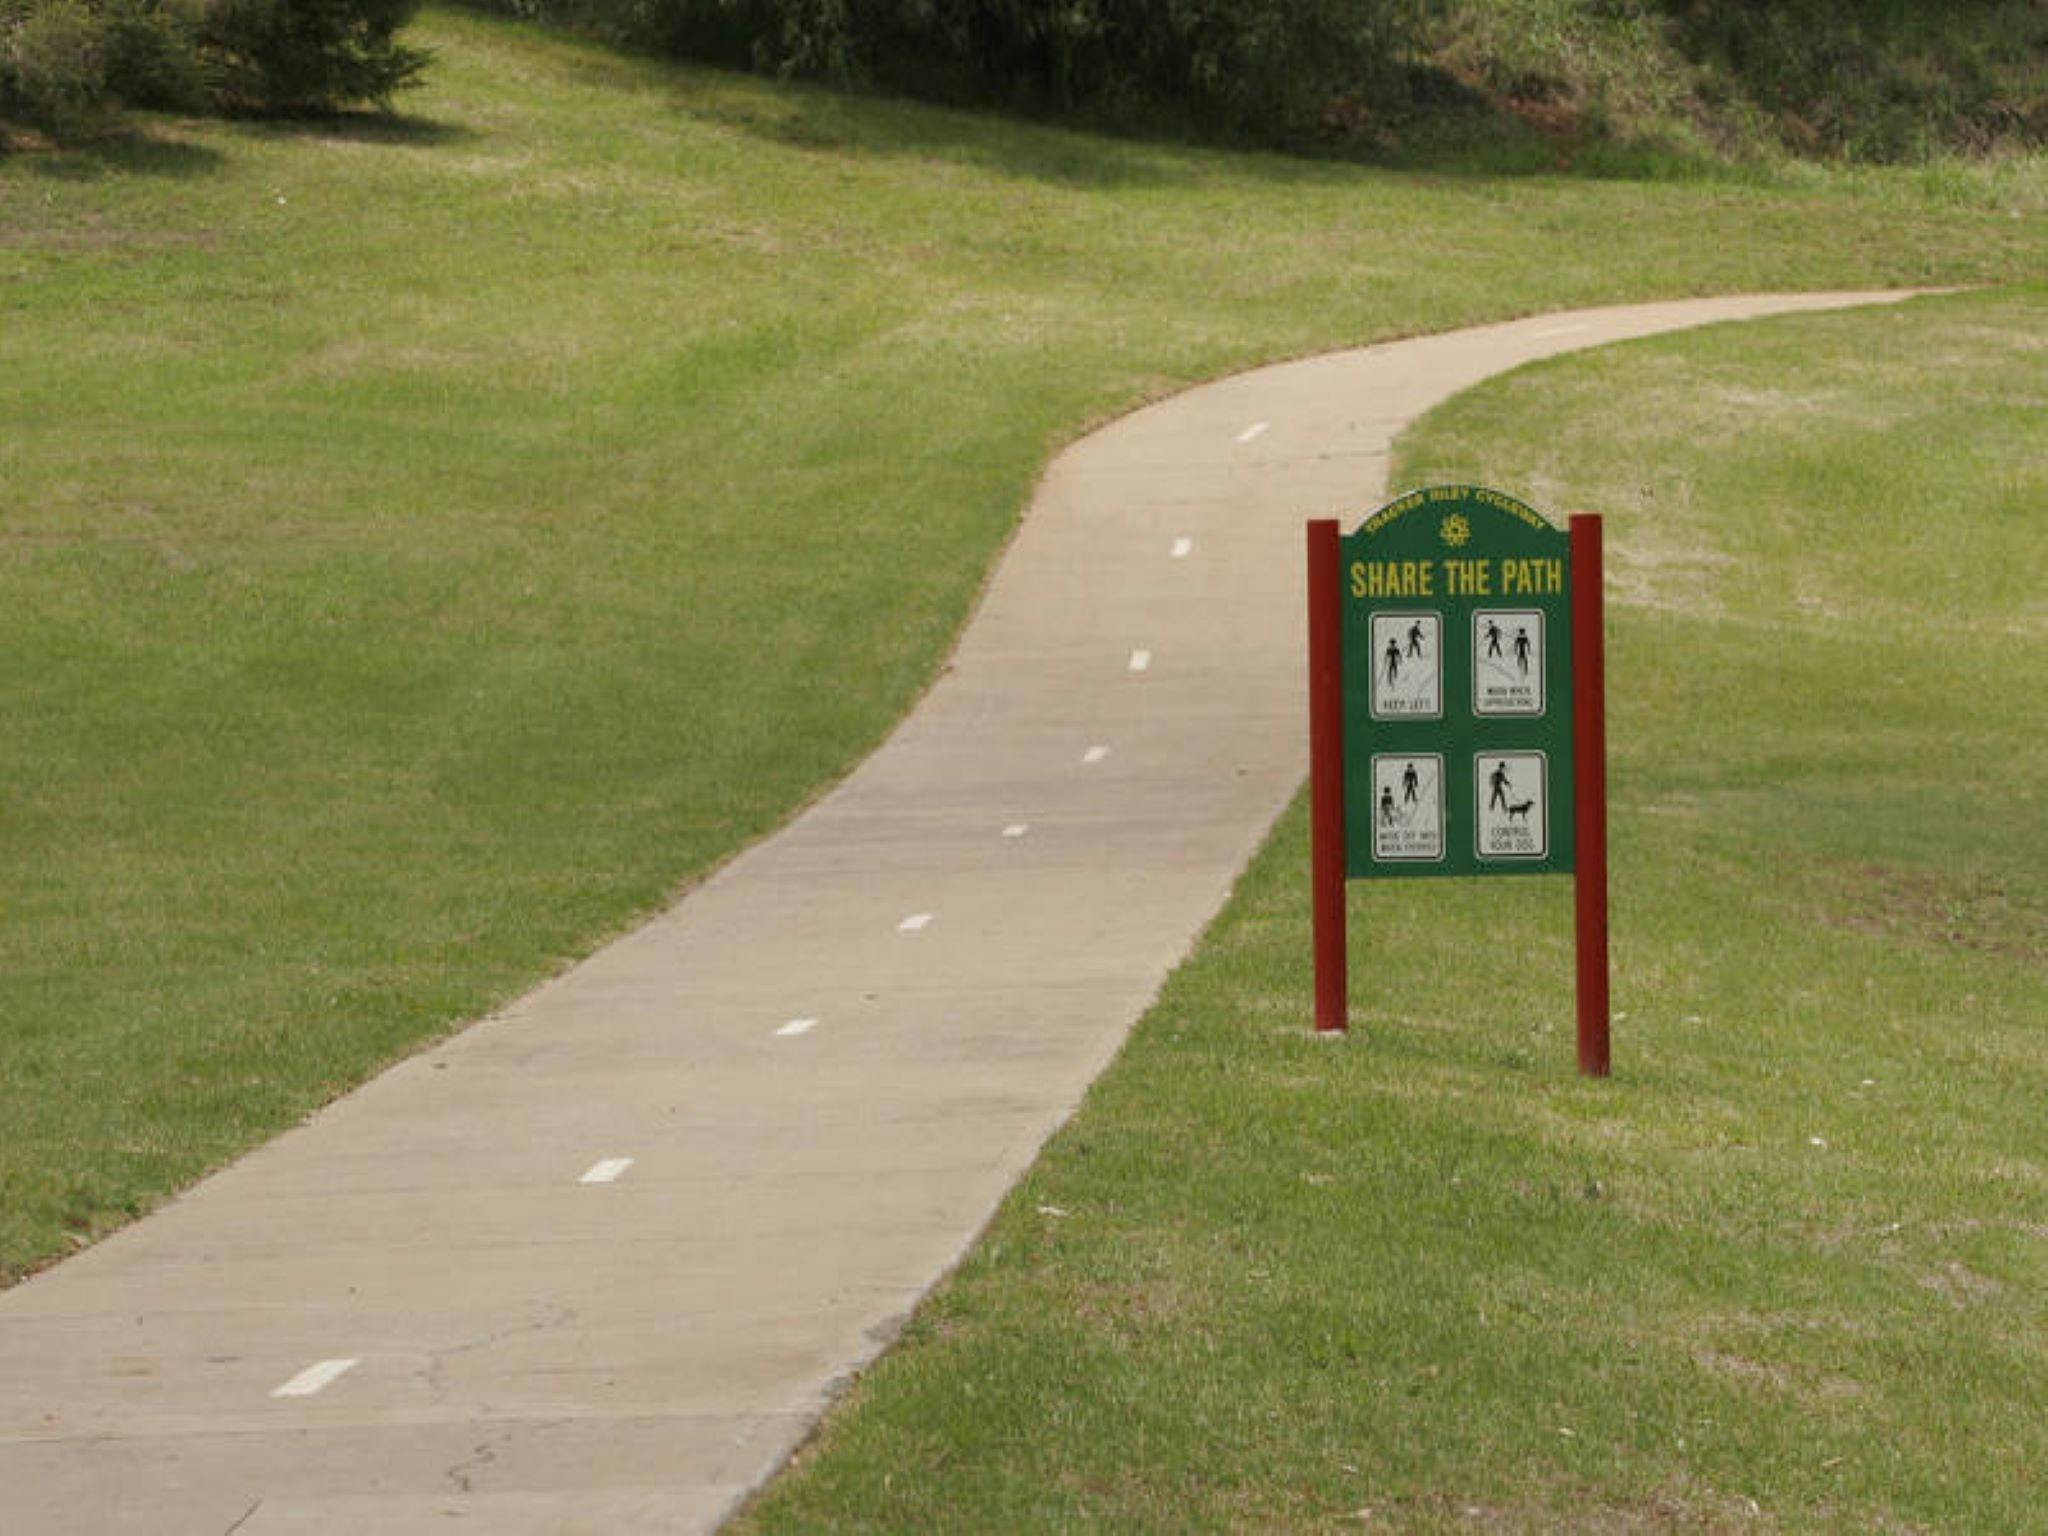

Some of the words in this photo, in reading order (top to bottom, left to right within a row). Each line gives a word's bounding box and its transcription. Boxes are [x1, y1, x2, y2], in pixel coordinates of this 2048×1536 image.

[1350, 560, 1433, 598] SHARE
[1444, 558, 1491, 596] THE
[1502, 557, 1562, 596] PATH
